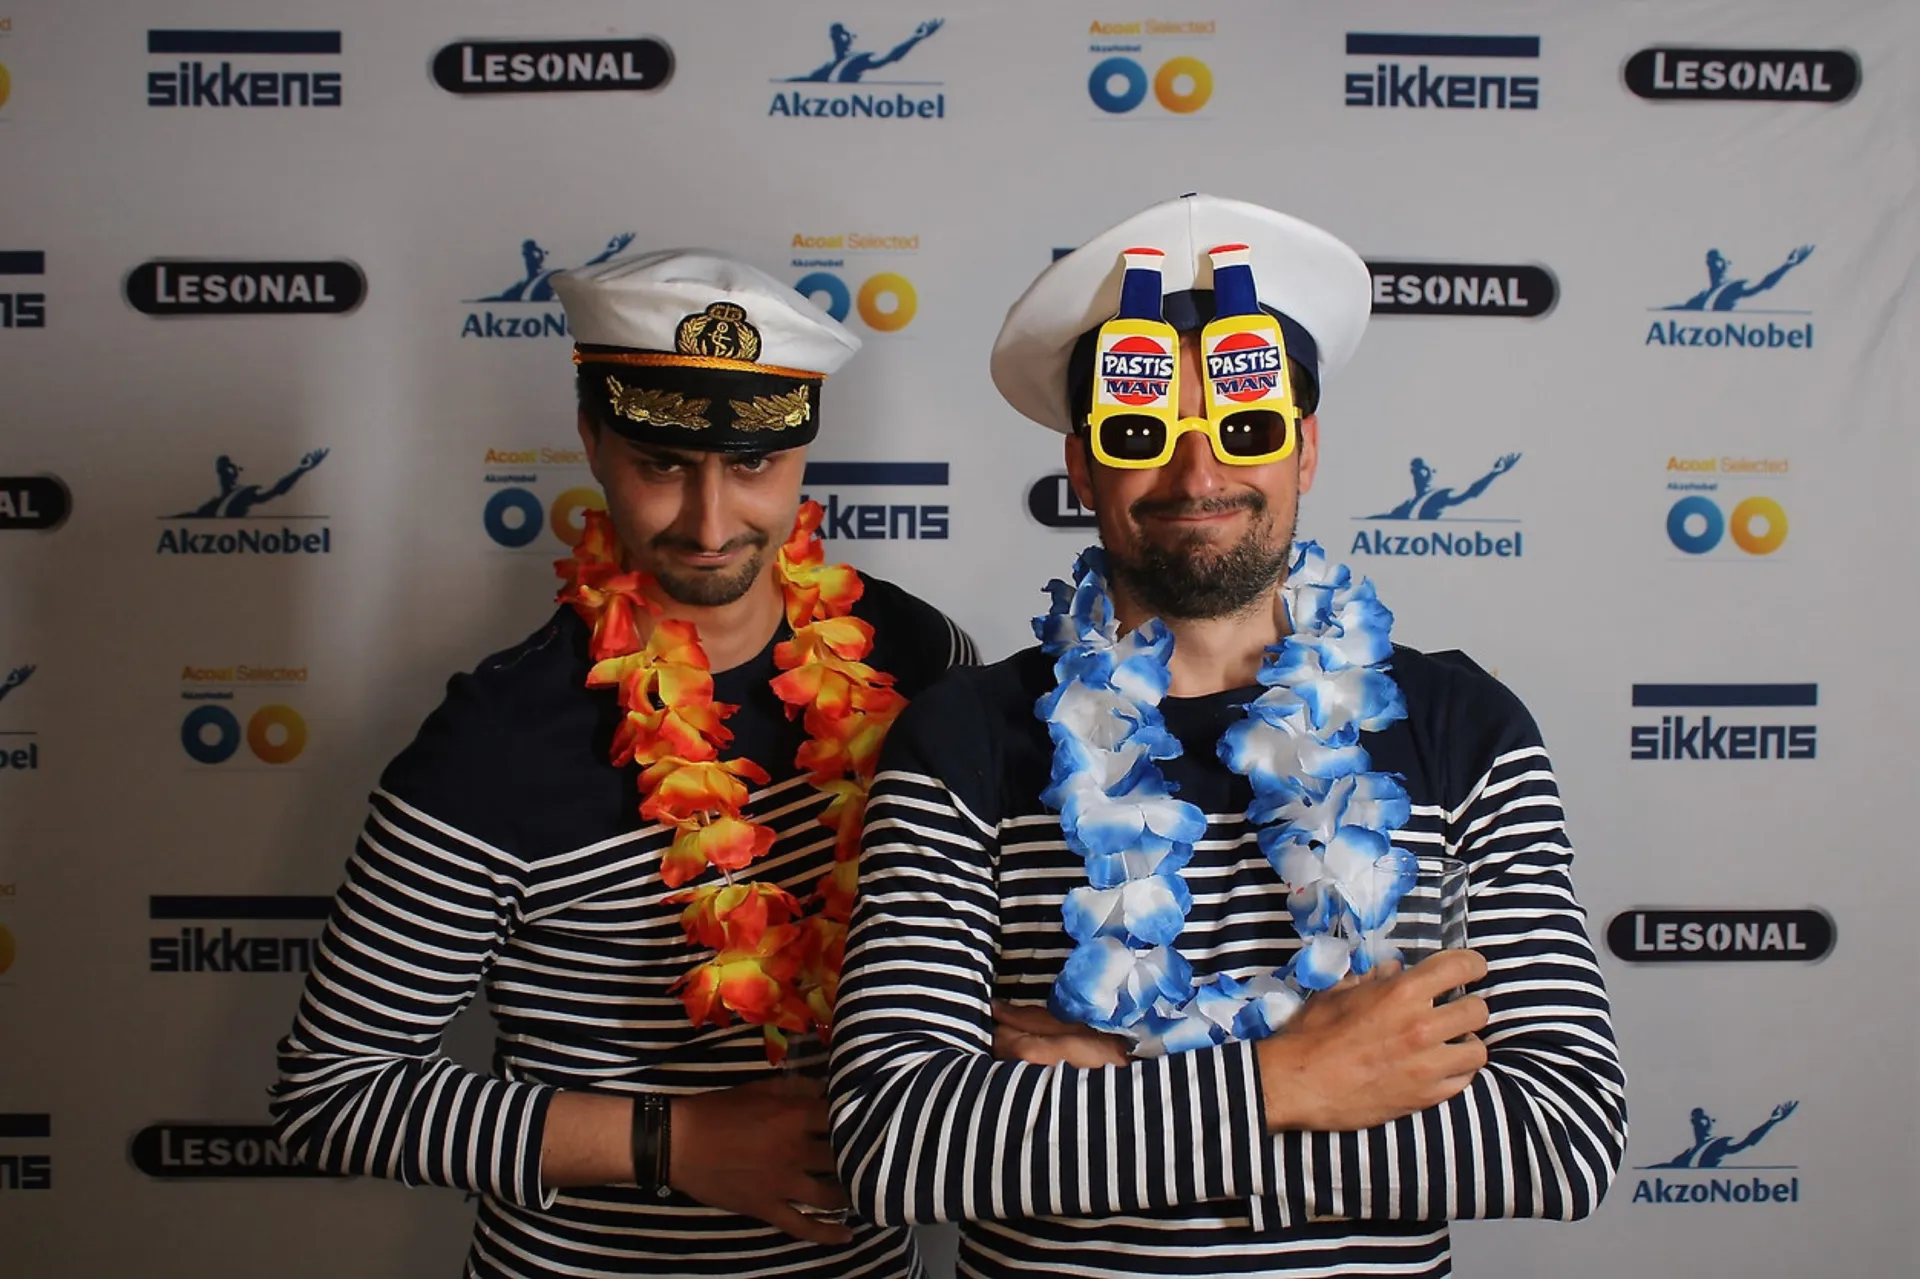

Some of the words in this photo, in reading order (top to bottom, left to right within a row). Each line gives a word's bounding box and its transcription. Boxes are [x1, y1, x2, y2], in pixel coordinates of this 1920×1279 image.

[1144, 20, 1216, 36] Selected
[462, 46, 643, 83] LESONAL
[1653, 52, 1832, 92] LESONAL
[147, 62, 342, 107] sikkens
[1345, 64, 1540, 110] sikkens
[768, 92, 945, 119] AkzoNobel
[847, 233, 919, 250] Selected
[156, 266, 335, 303] LESONAL
[1373, 274, 1529, 307] ESONAL
[461, 312, 565, 338] AkzoN
[1645, 321, 1814, 349] AkzoNobel
[1106, 379, 1168, 396] MAN
[1216, 375, 1277, 395] MAN
[541, 448, 585, 464] Selec
[1720, 457, 1789, 474] Selected
[800, 494, 950, 540] kens
[157, 527, 331, 554] AkzoNobel
[1351, 530, 1523, 558] AkzoNobel
[237, 665, 308, 682] Selected
[1631, 716, 1817, 761] sikkens
[1634, 914, 1807, 951] LESONAL
[161, 1129, 298, 1166] LESON
[1632, 1177, 1799, 1204] AkzoNobel
